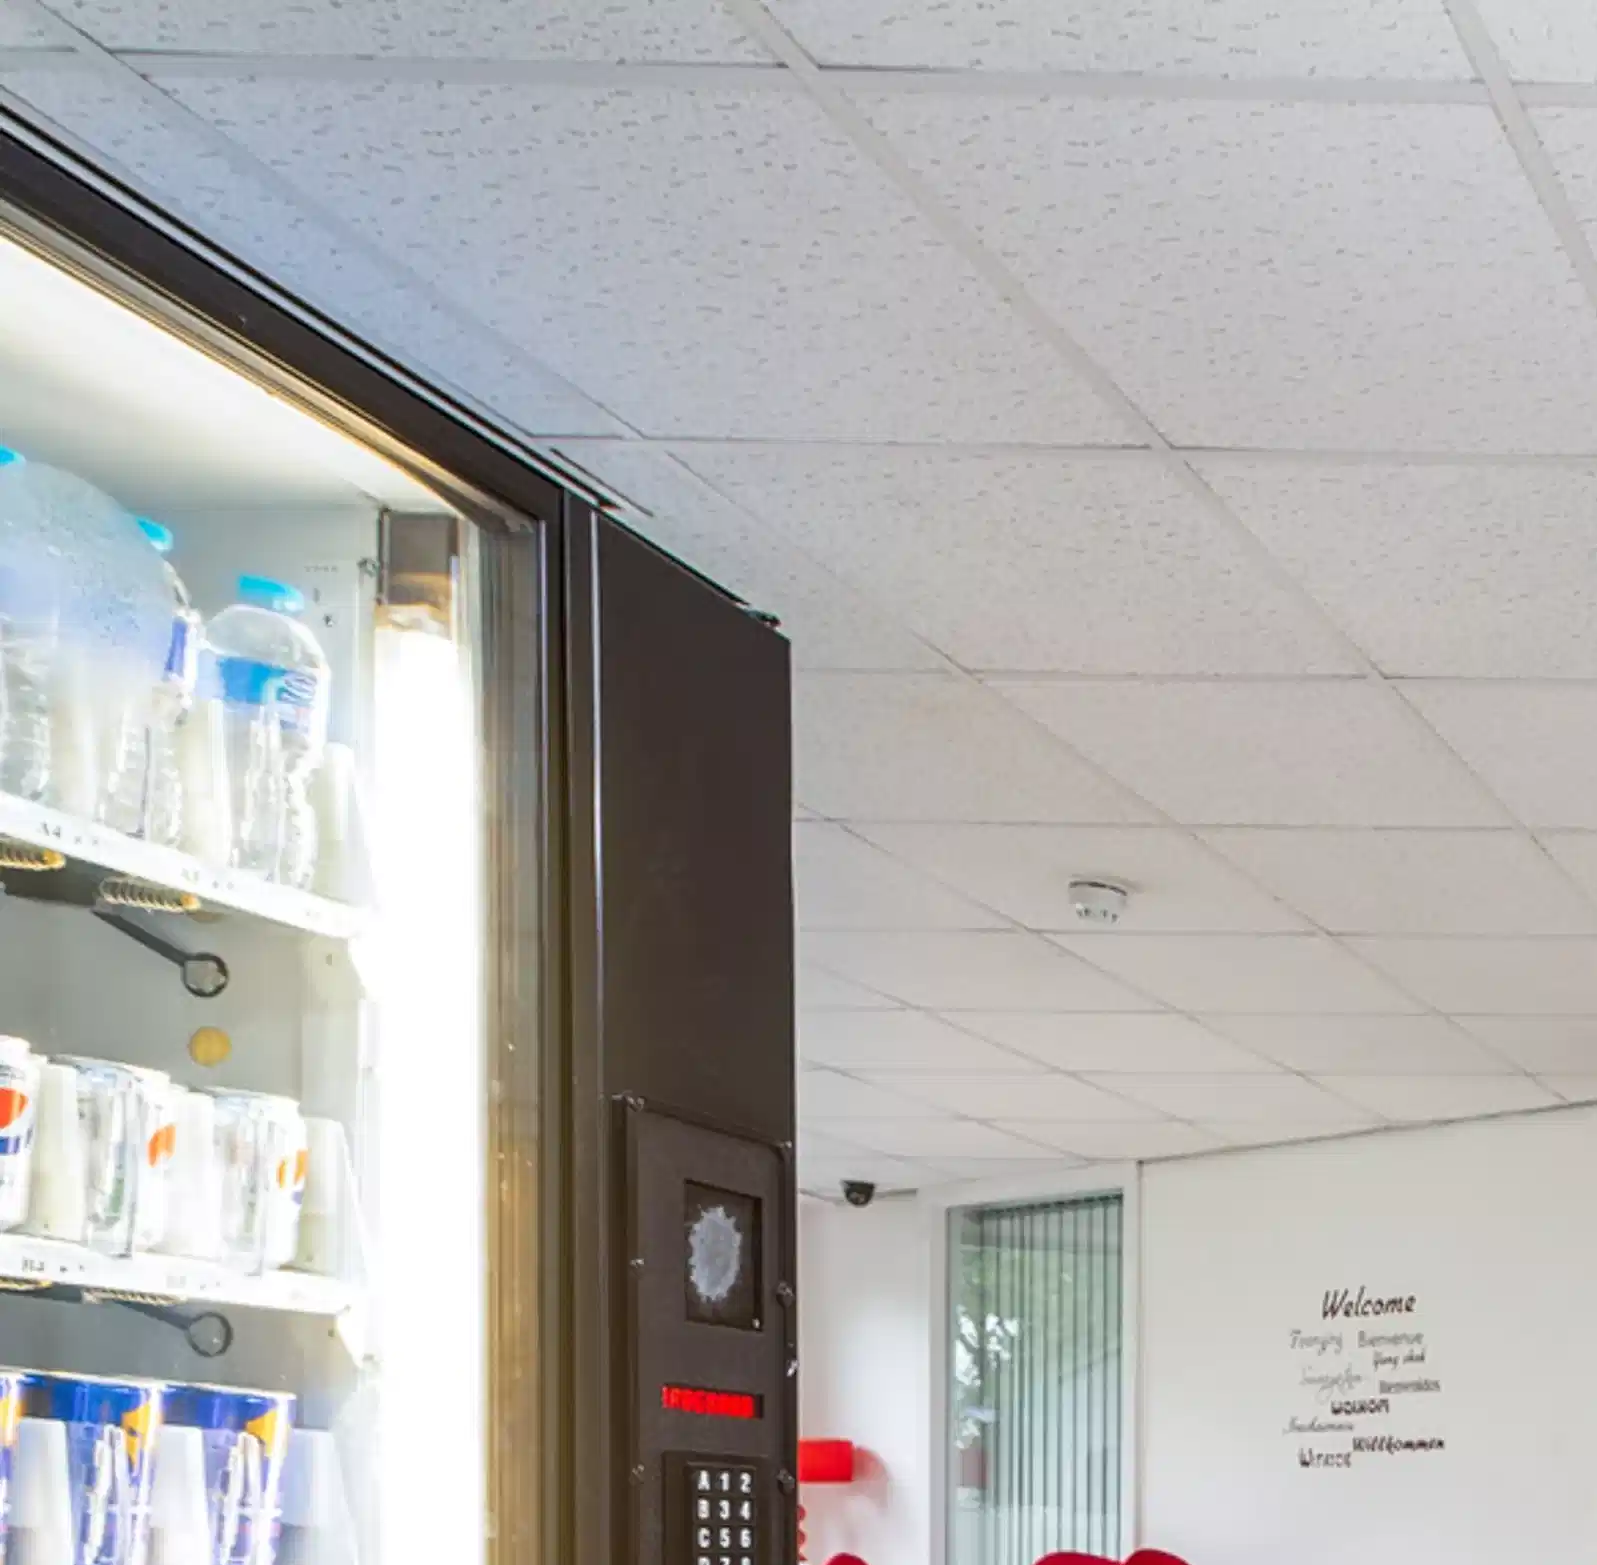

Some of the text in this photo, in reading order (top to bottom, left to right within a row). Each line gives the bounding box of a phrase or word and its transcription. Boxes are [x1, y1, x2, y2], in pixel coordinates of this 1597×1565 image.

[1321, 1285, 1417, 1320] Welcome
[697, 1470, 752, 1493] A 1 2
[719, 1499, 730, 1521] 3
[739, 1500, 751, 1521] 4
[698, 1527, 752, 1549] C 5 6
